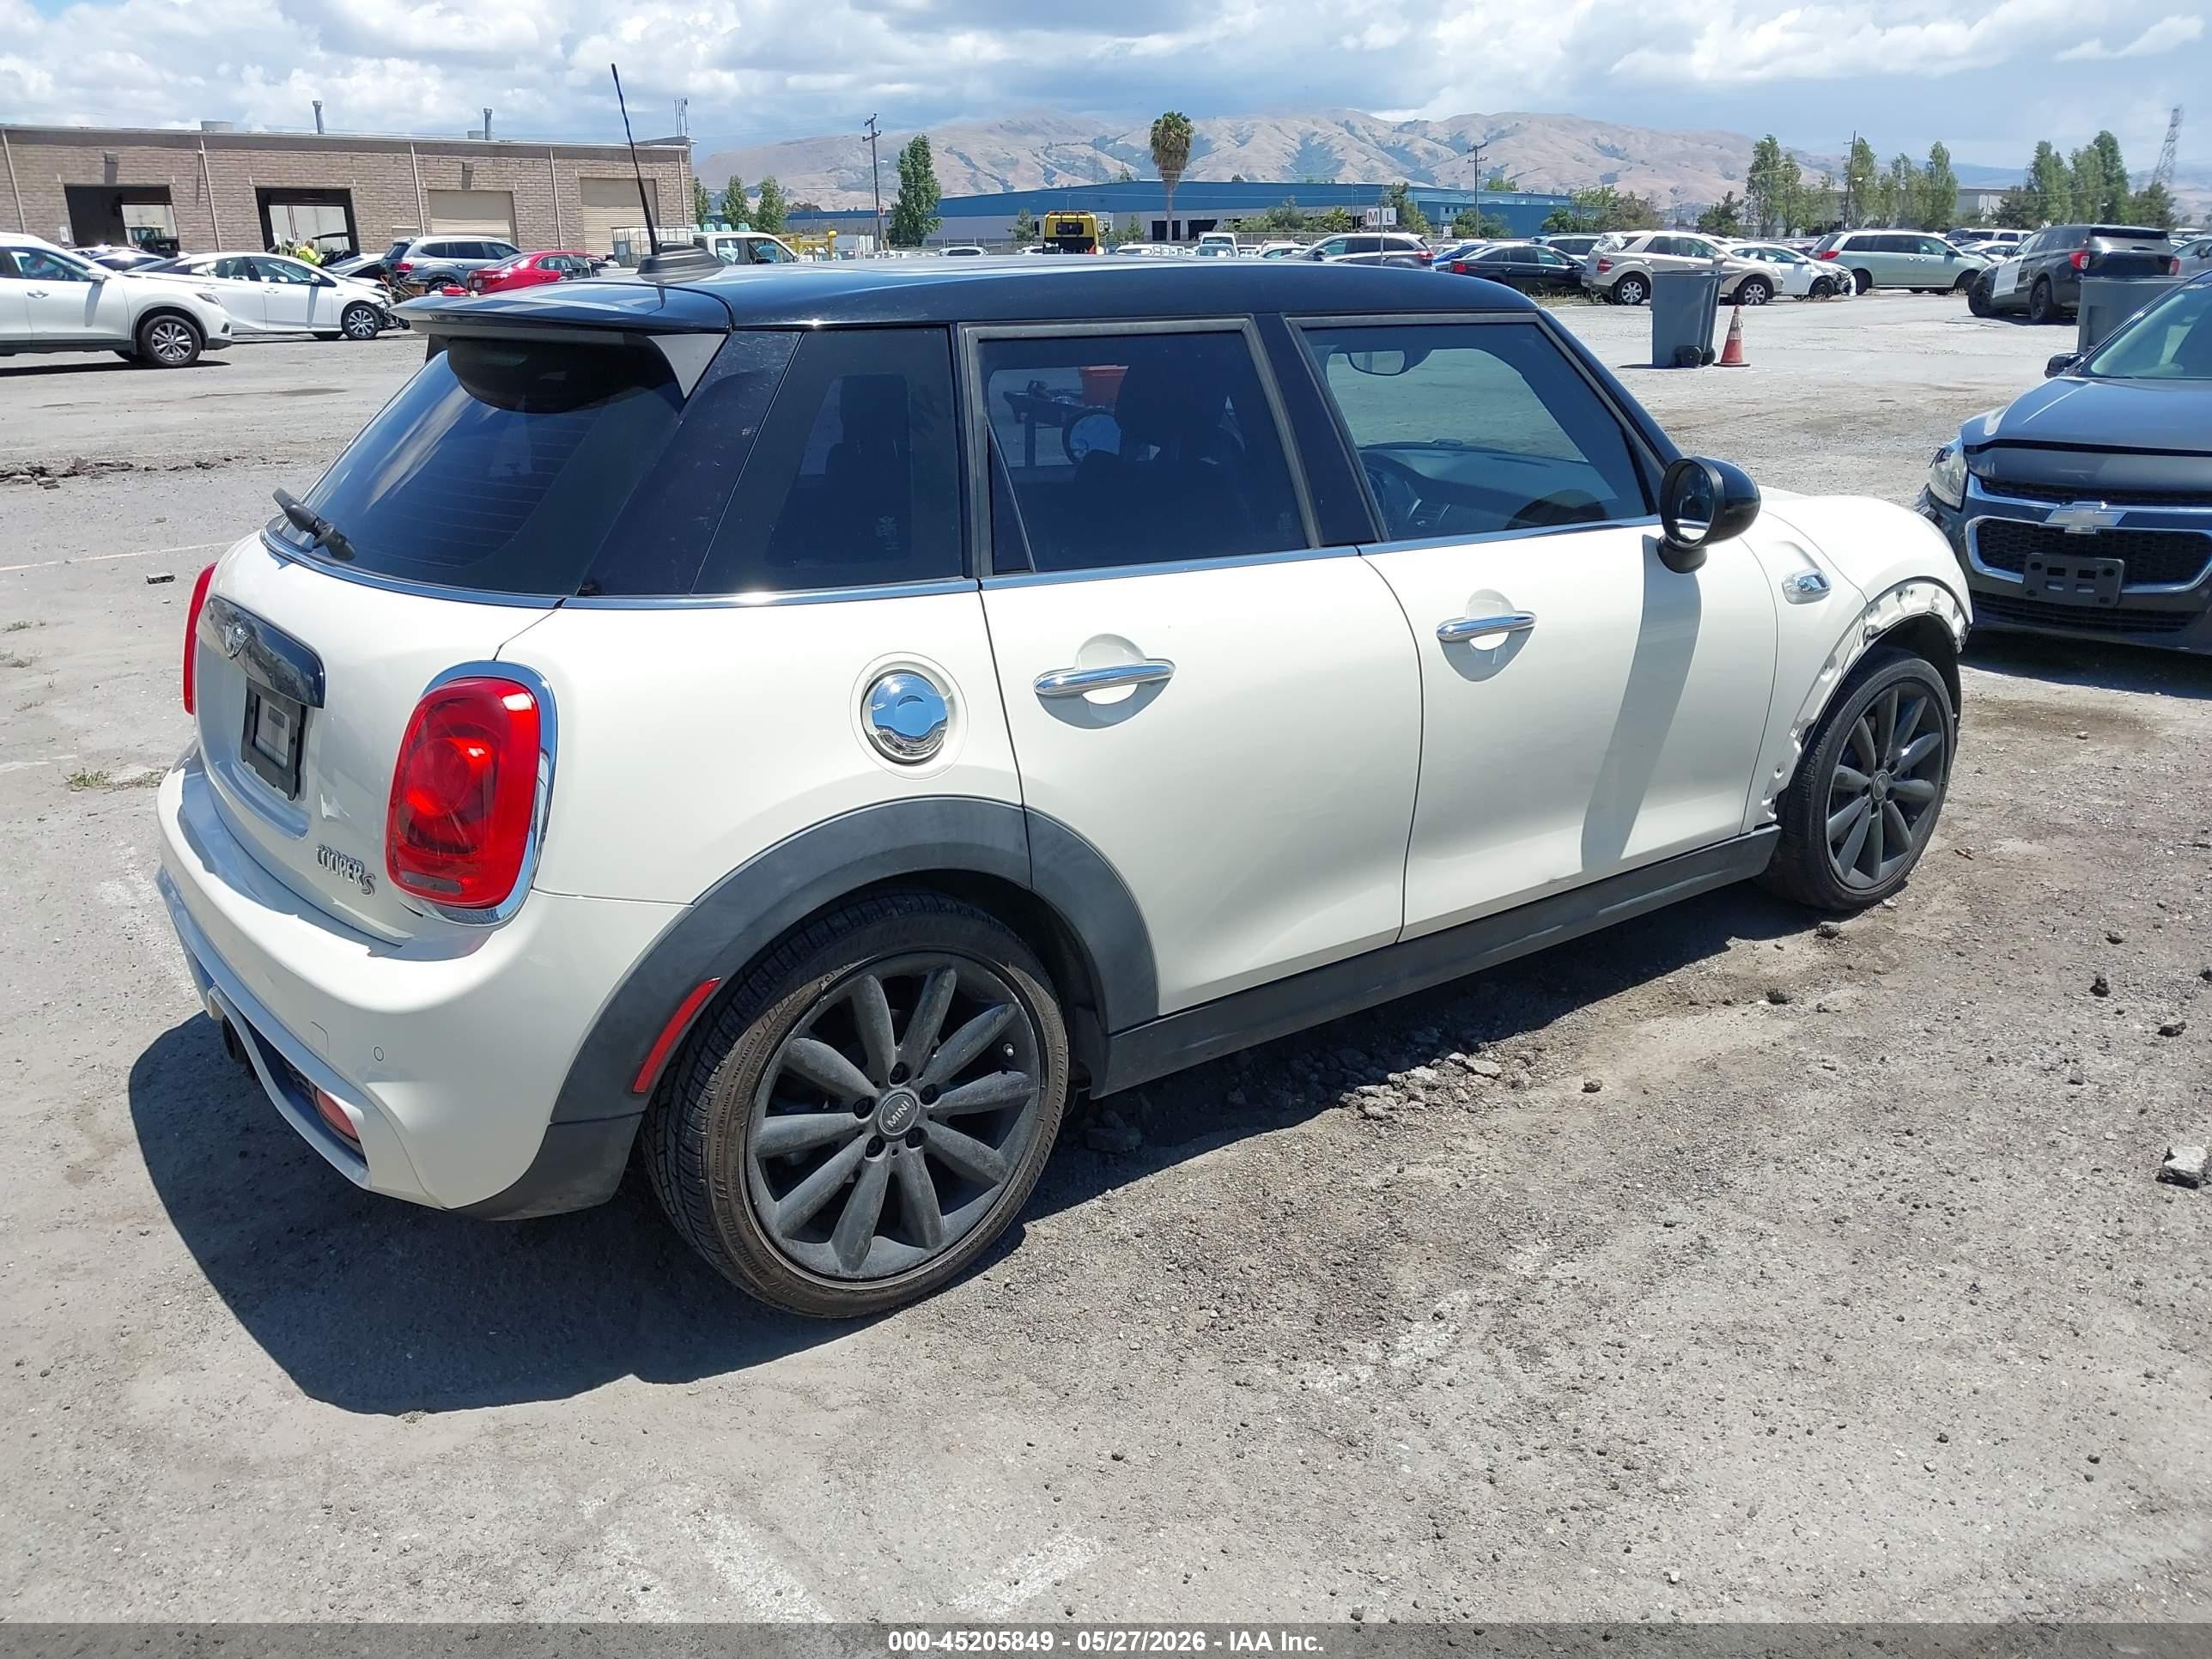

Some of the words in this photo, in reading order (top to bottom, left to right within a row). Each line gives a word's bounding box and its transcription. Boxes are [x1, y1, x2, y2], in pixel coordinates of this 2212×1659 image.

[1368, 211, 1378, 223] M
[1386, 211, 1393, 222] L
[315, 844, 365, 887] COOPER
[362, 872, 376, 896] S
[887, 1101, 910, 1127] MINI
